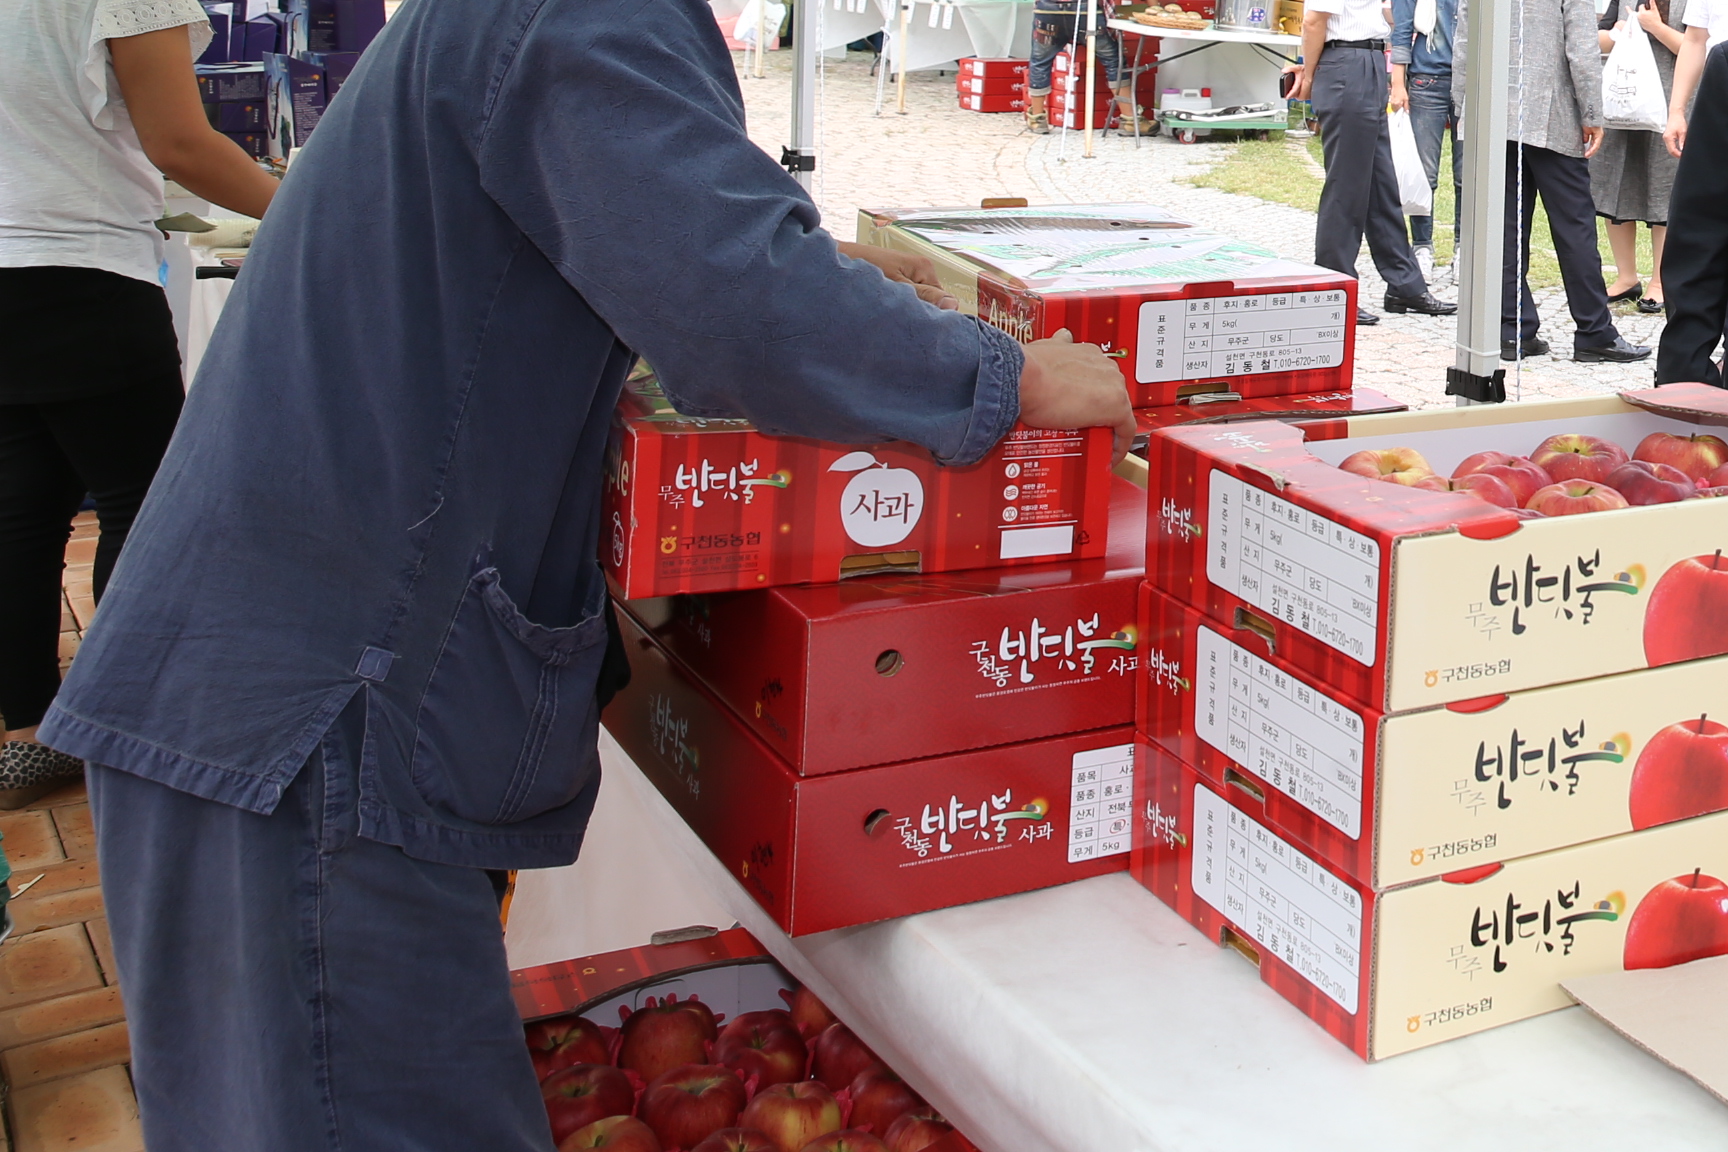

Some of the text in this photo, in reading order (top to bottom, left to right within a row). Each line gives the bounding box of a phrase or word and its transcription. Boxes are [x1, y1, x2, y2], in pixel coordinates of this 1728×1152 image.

[1272, 298, 1286, 306] 등급
[1228, 334, 1283, 346] 무주군 당도
[1186, 348, 1302, 370] 생산자 설천면 구천동로 805-13
[676, 458, 788, 508] 반딧불
[849, 490, 915, 524] 사과
[1311, 519, 1325, 536] 등급
[681, 531, 761, 550] 구천동농협
[1274, 559, 1322, 592] 무주군 당도
[1241, 574, 1259, 593] 생산자
[1316, 604, 1338, 624] 805-13
[1489, 548, 1639, 636] 반딧불
[999, 613, 1135, 683] 반딧불
[1441, 658, 1511, 683] 구천동농협
[1297, 687, 1310, 704] 등급
[1229, 733, 1247, 753] 생산자
[1261, 722, 1308, 760] 무주군 당도
[1475, 719, 1624, 810] 반딧불
[1077, 770, 1096, 783] 품목
[1076, 788, 1096, 801] 품종
[921, 788, 1043, 853] 반딧불
[1019, 821, 1054, 843] 사과
[1075, 802, 1126, 820] 산지 전북
[1074, 826, 1094, 839] 등급
[1073, 840, 1120, 858] 무게 5kg
[1426, 832, 1497, 861] 구천동농협
[1226, 894, 1244, 915] 생산자
[1258, 886, 1277, 909] 무주군
[1470, 879, 1619, 973] 반딧불
[1423, 996, 1493, 1027] 구천동농협
